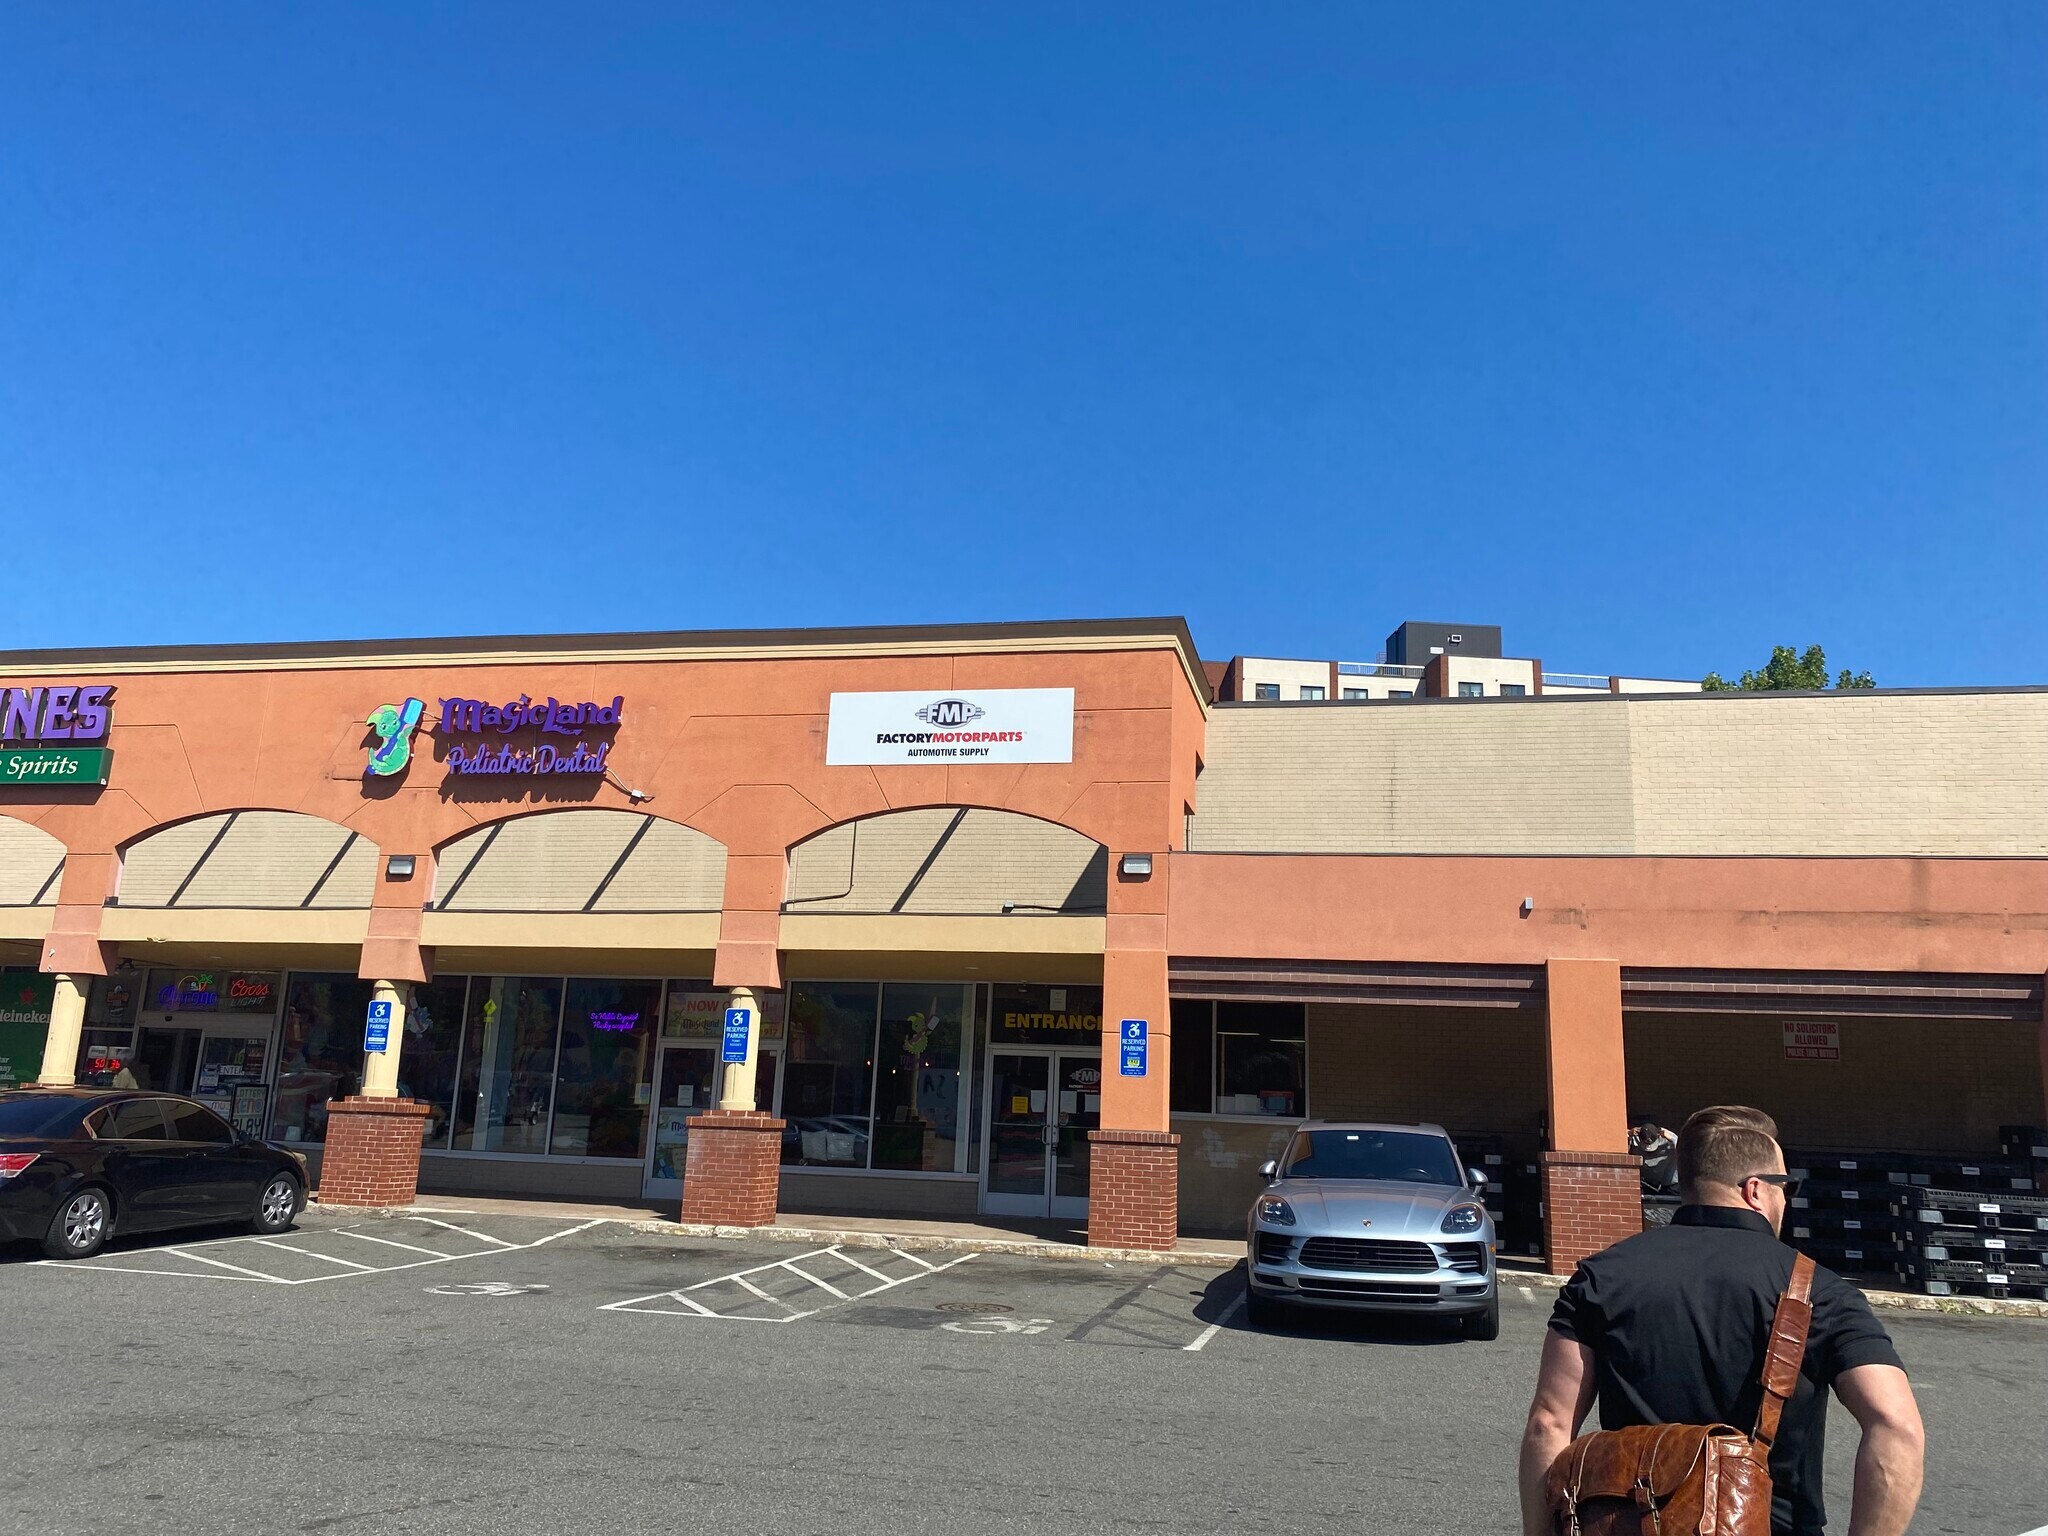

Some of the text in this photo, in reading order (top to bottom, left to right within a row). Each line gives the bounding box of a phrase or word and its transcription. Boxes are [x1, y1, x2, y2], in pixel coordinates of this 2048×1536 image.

[926, 703, 976, 724] FMP
[447, 741, 608, 775] Pediatric Dental
[907, 748, 990, 757] AUTOMOTIVE SUPPLY
[6, 755, 79, 780] Spirits
[230, 979, 270, 997] Coors
[687, 999, 719, 1012] NOW
[1784, 1022, 1837, 1035] NO SOLICITORS
[1794, 1034, 1828, 1046] ALLOWED
